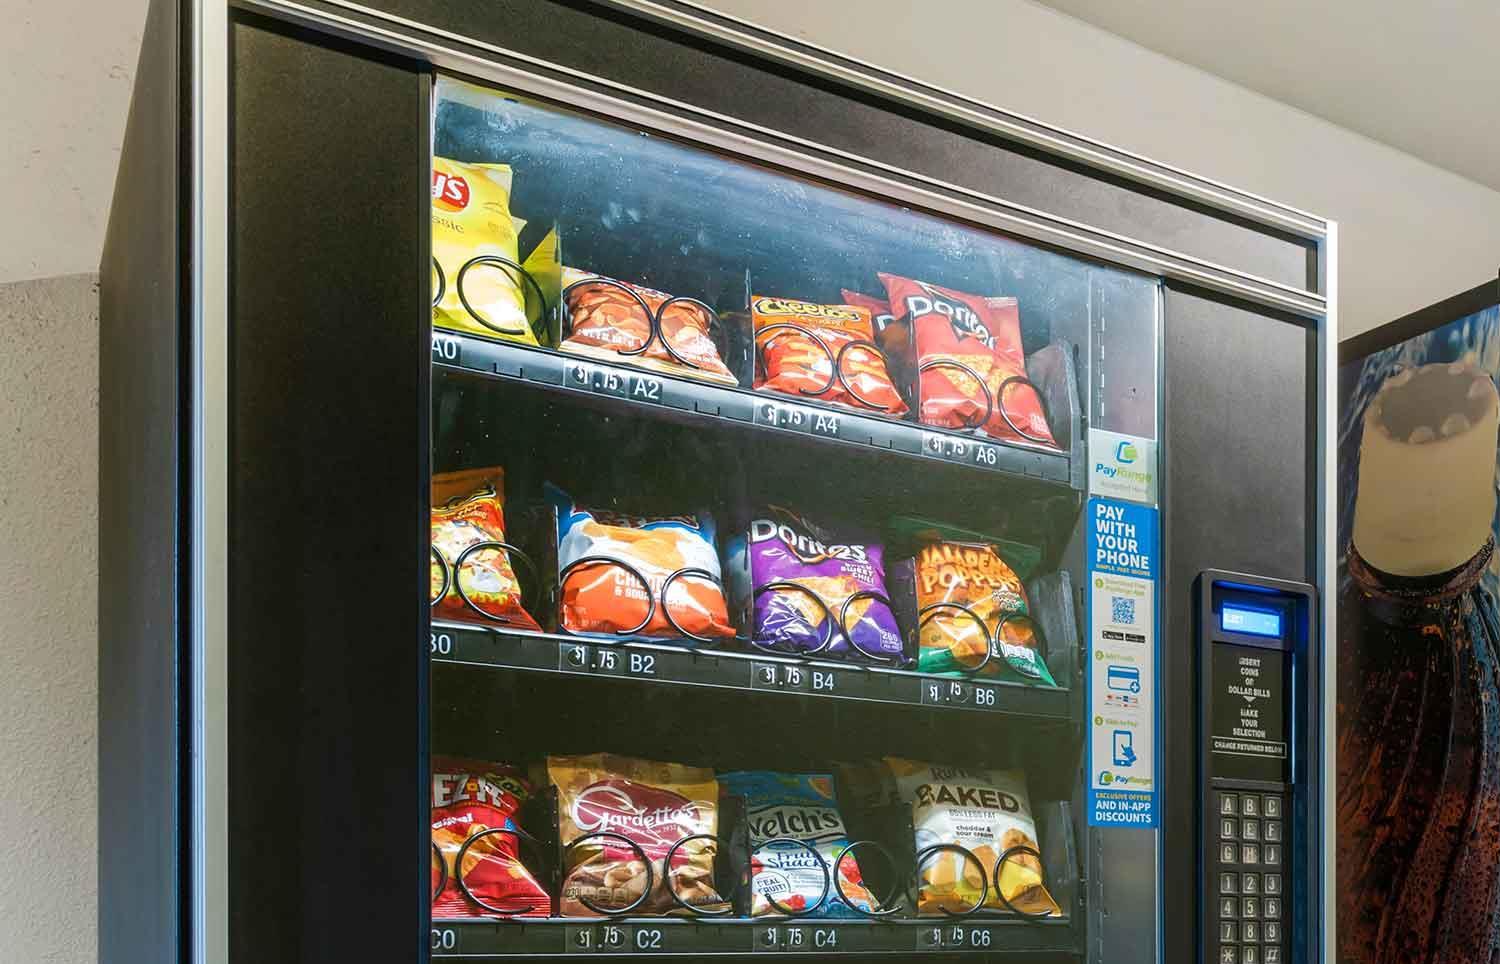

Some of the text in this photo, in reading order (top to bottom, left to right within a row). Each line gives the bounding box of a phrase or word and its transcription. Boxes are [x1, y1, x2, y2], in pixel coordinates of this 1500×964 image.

[907, 296, 997, 350] Doritos
[634, 376, 659, 400] A2
[816, 414, 837, 433] A4
[976, 448, 996, 465] A6
[1096, 503, 1125, 521] PAY
[1096, 518, 1136, 538] WITH
[752, 518, 866, 562] Doritos
[1096, 533, 1138, 553] YOUR
[1096, 549, 1150, 570] PHONE
[631, 654, 655, 674] B2
[813, 672, 834, 691] B4
[976, 688, 995, 706] B6
[1240, 718, 1258, 728] YOUR
[1232, 728, 1266, 739] SELECTION
[915, 783, 1020, 812] BAKED
[1096, 800, 1151, 811] AND IN-APP
[1096, 811, 1152, 823] DISCOUNTS
[637, 930, 661, 949] C2
[815, 930, 836, 947] C4
[971, 929, 990, 946] C6
